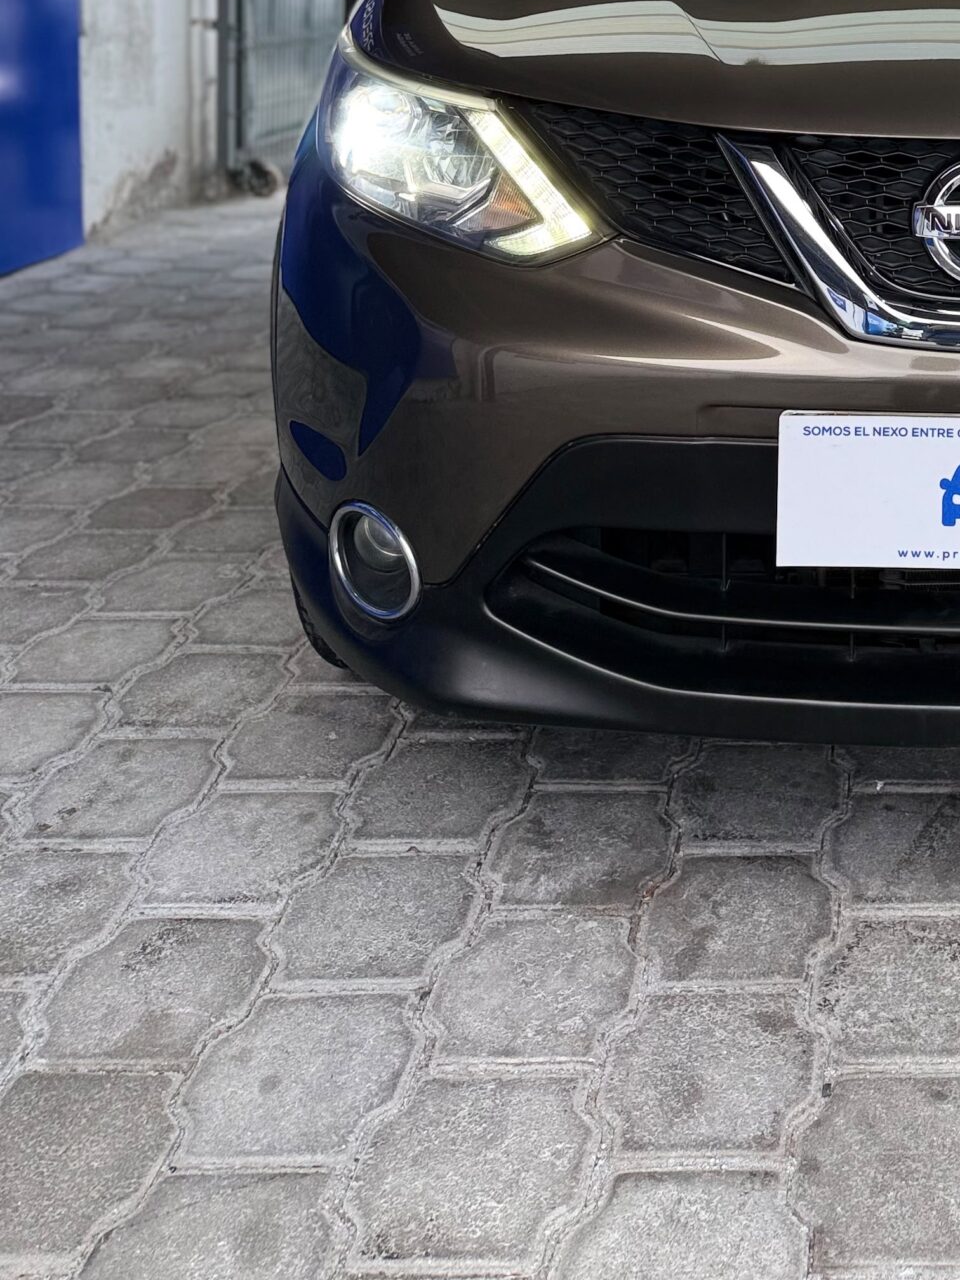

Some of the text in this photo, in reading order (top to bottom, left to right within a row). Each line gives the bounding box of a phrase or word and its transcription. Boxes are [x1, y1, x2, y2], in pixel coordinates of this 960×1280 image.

[802, 425, 851, 437] SOMOS
[854, 426, 870, 437] EL
[872, 426, 909, 438] NEXO
[911, 427, 954, 439] ENTRE
